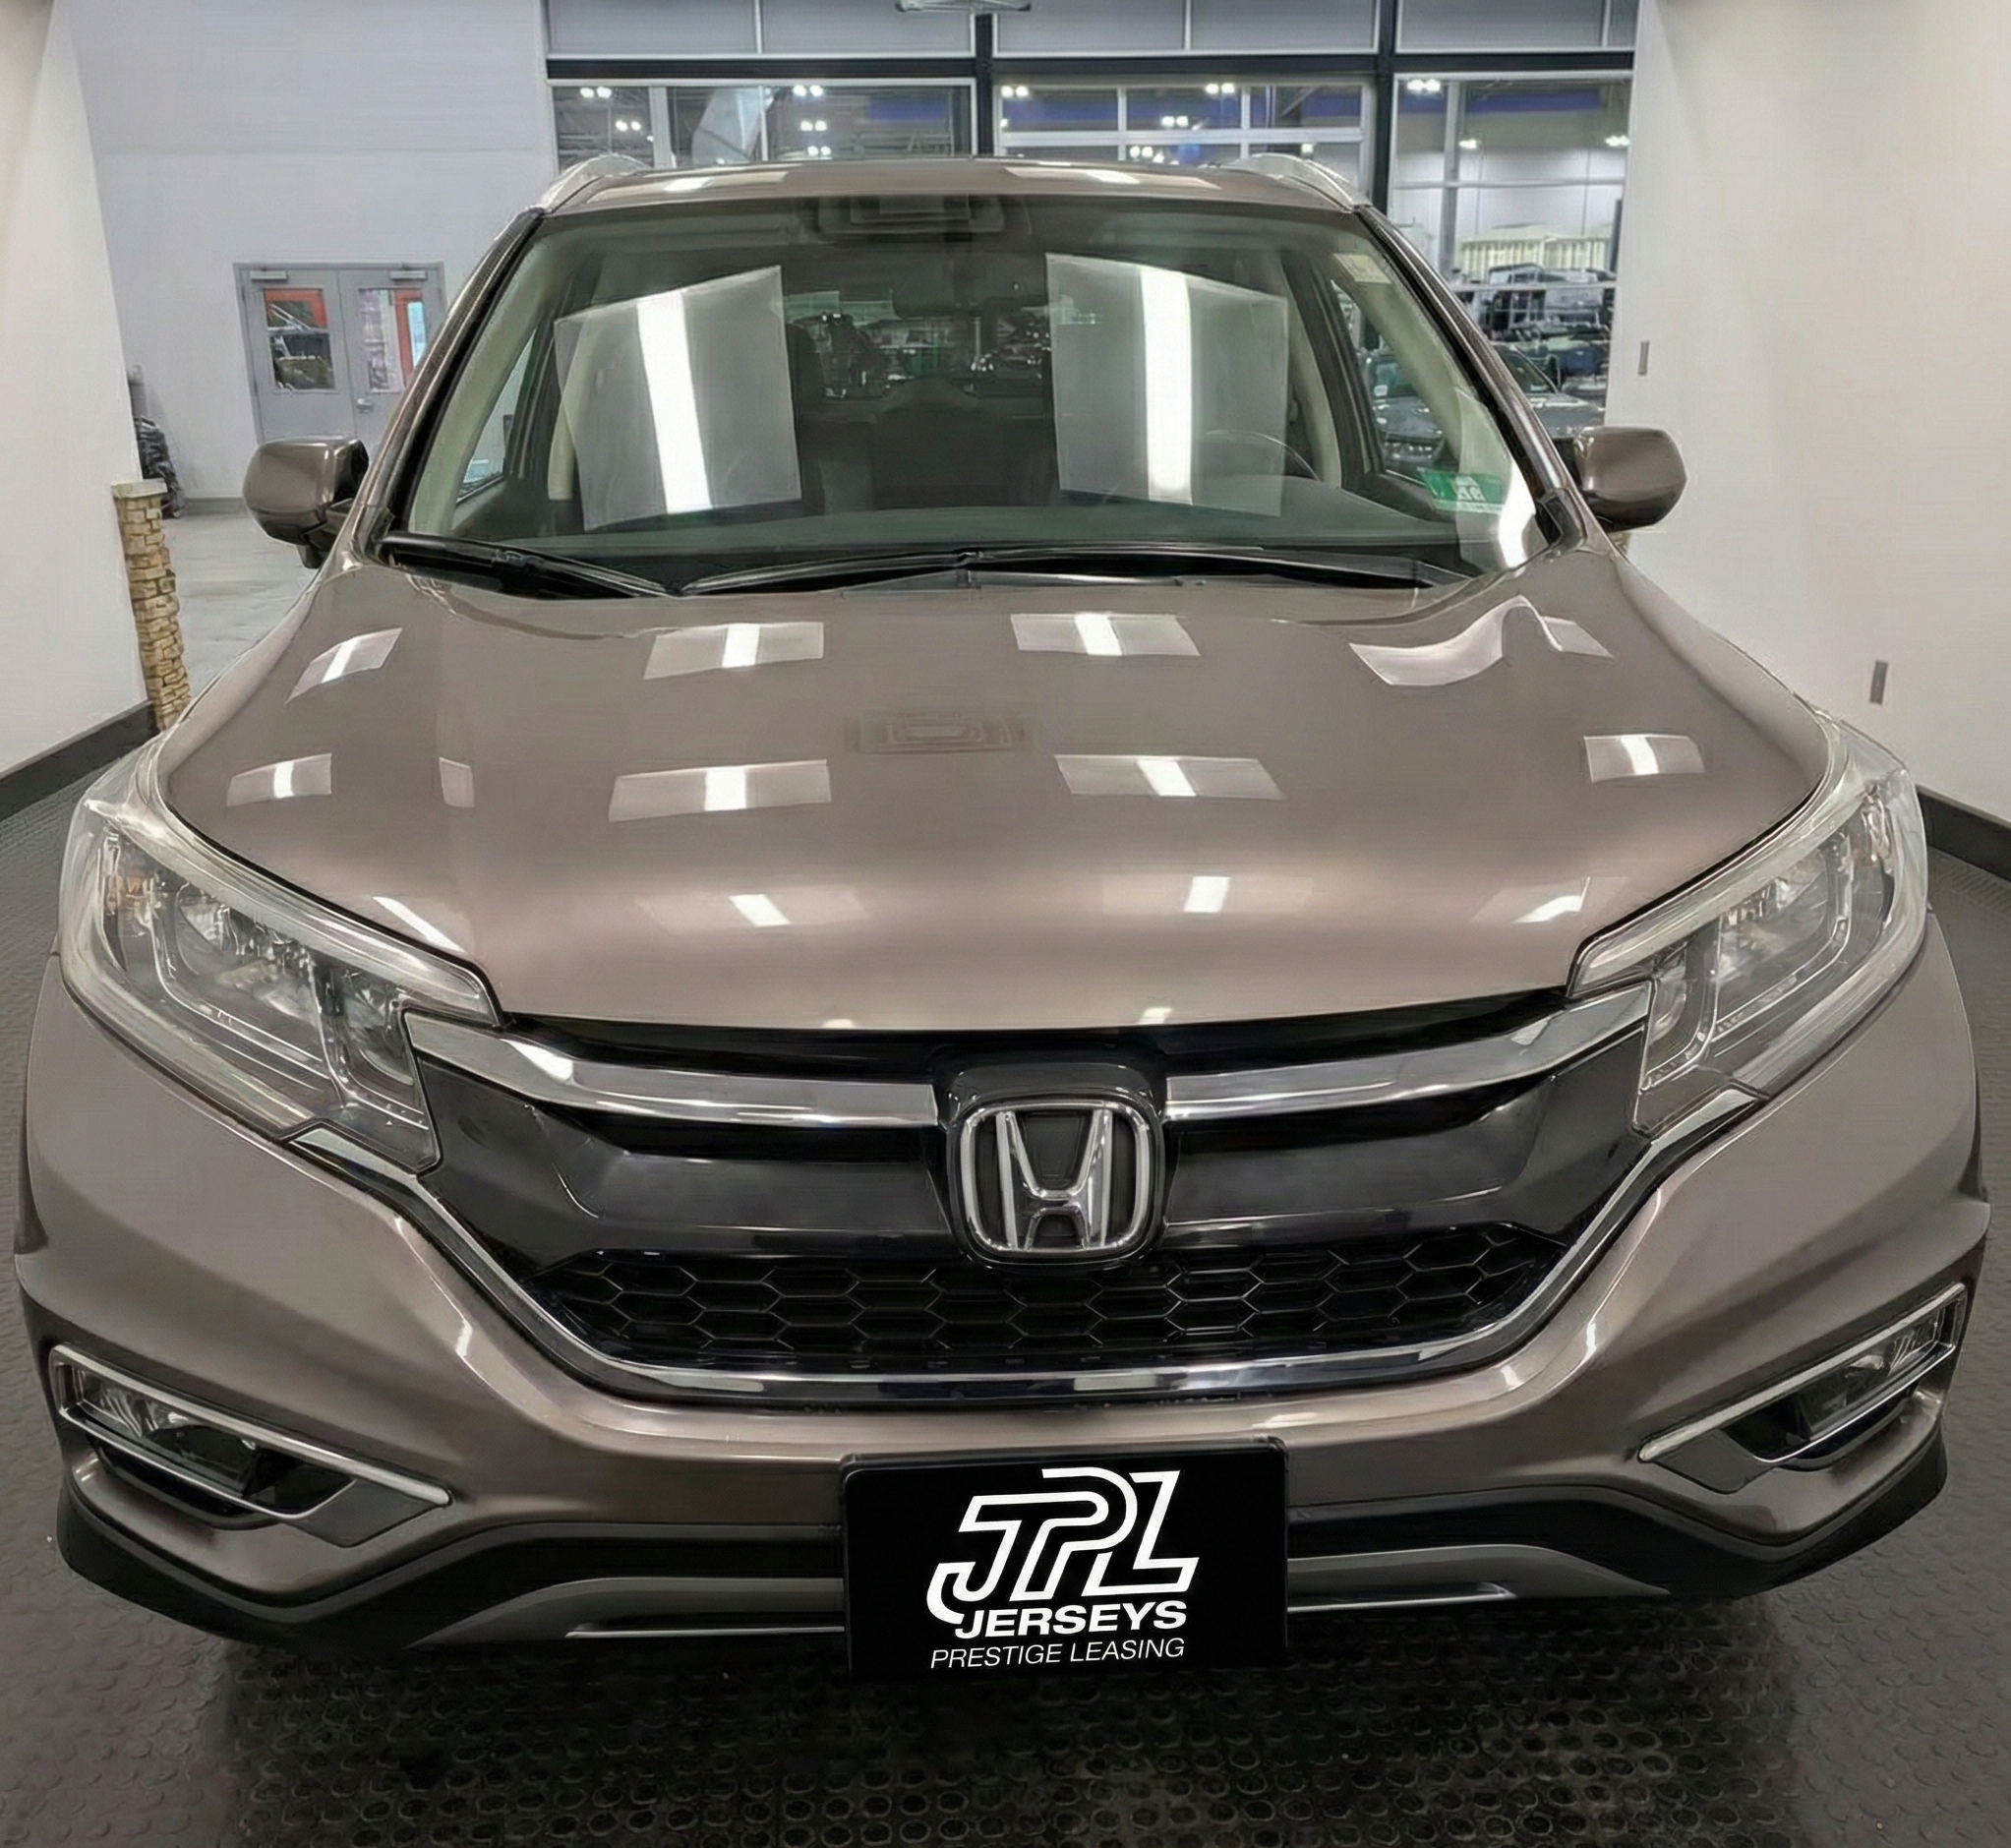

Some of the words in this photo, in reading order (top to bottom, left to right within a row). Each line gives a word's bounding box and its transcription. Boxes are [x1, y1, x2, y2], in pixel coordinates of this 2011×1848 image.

[954, 1599, 1188, 1639] JERSEYS
[929, 1643, 1063, 1669] PRESTIGE
[1069, 1637, 1186, 1663] LEASING
